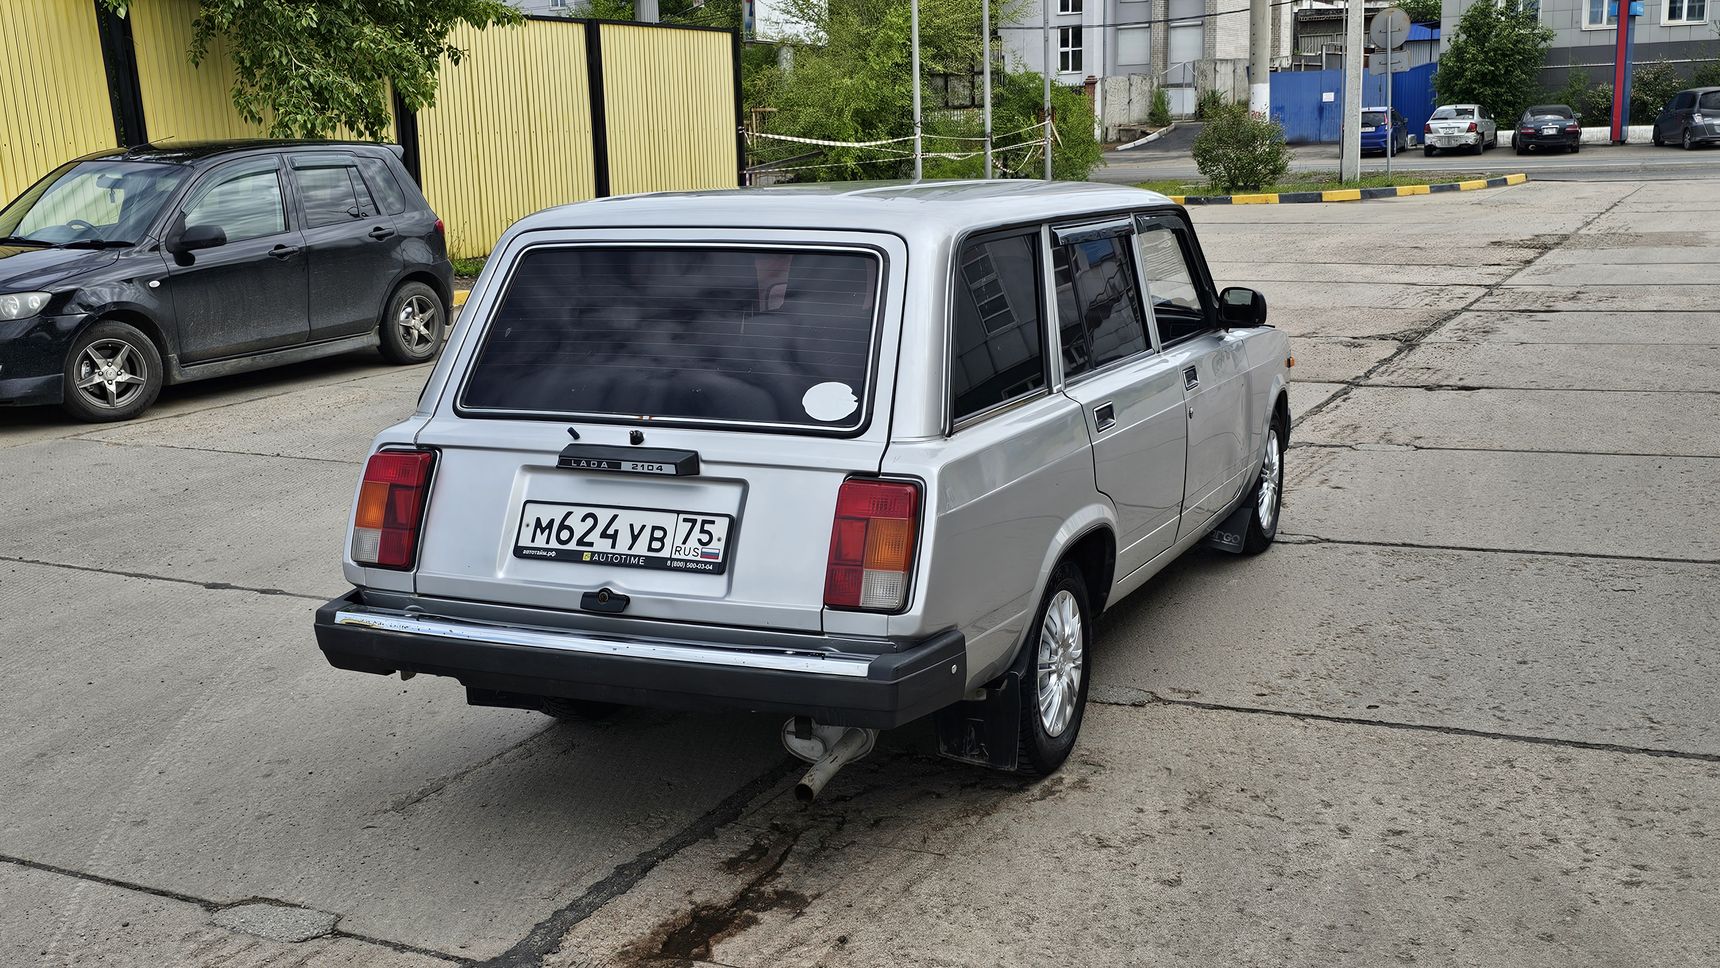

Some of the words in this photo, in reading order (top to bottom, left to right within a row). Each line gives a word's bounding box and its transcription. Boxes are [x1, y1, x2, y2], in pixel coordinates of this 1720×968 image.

[571, 459, 609, 469] LADA
[631, 463, 664, 472] 2104
[681, 517, 716, 546] 75
[674, 545, 700, 558] RUS
[592, 553, 646, 565] AUTOTIME
[671, 560, 686, 569] (800)
[686, 562, 713, 571] 500-03-04
